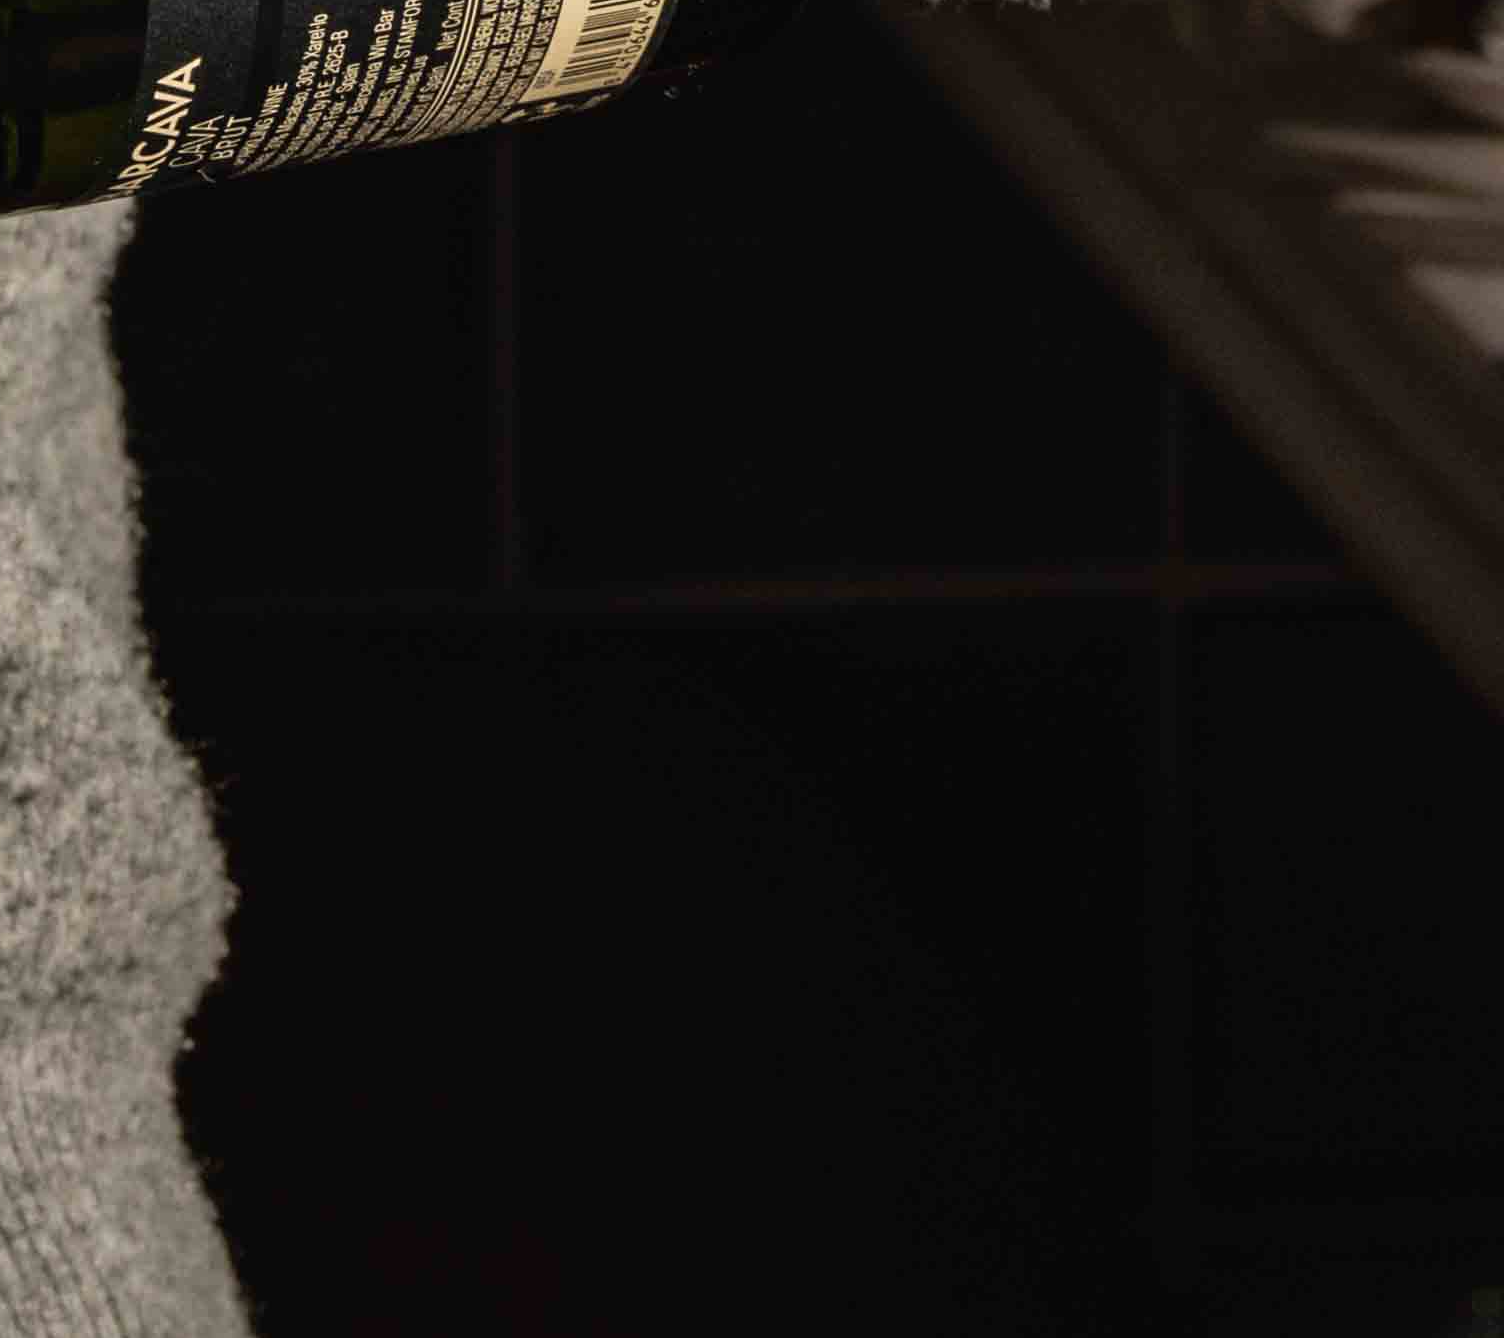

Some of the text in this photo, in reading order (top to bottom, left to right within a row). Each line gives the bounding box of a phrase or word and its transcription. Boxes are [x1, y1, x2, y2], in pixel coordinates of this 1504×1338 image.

[441, 0, 464, 28] Cont
[492, 9, 517, 45] BECAUSE
[322, 29, 348, 74] 2625-B
[435, 29, 457, 50] Net
[296, 60, 318, 87] 30%
[335, 62, 360, 93] Spain
[346, 61, 382, 113] Barcelona
[374, 9, 394, 32] Bar
[260, 83, 287, 116] WINE
[92, 56, 202, 202] ARCAVA
[168, 115, 224, 168] CAVA
[210, 117, 250, 161] BRUT
